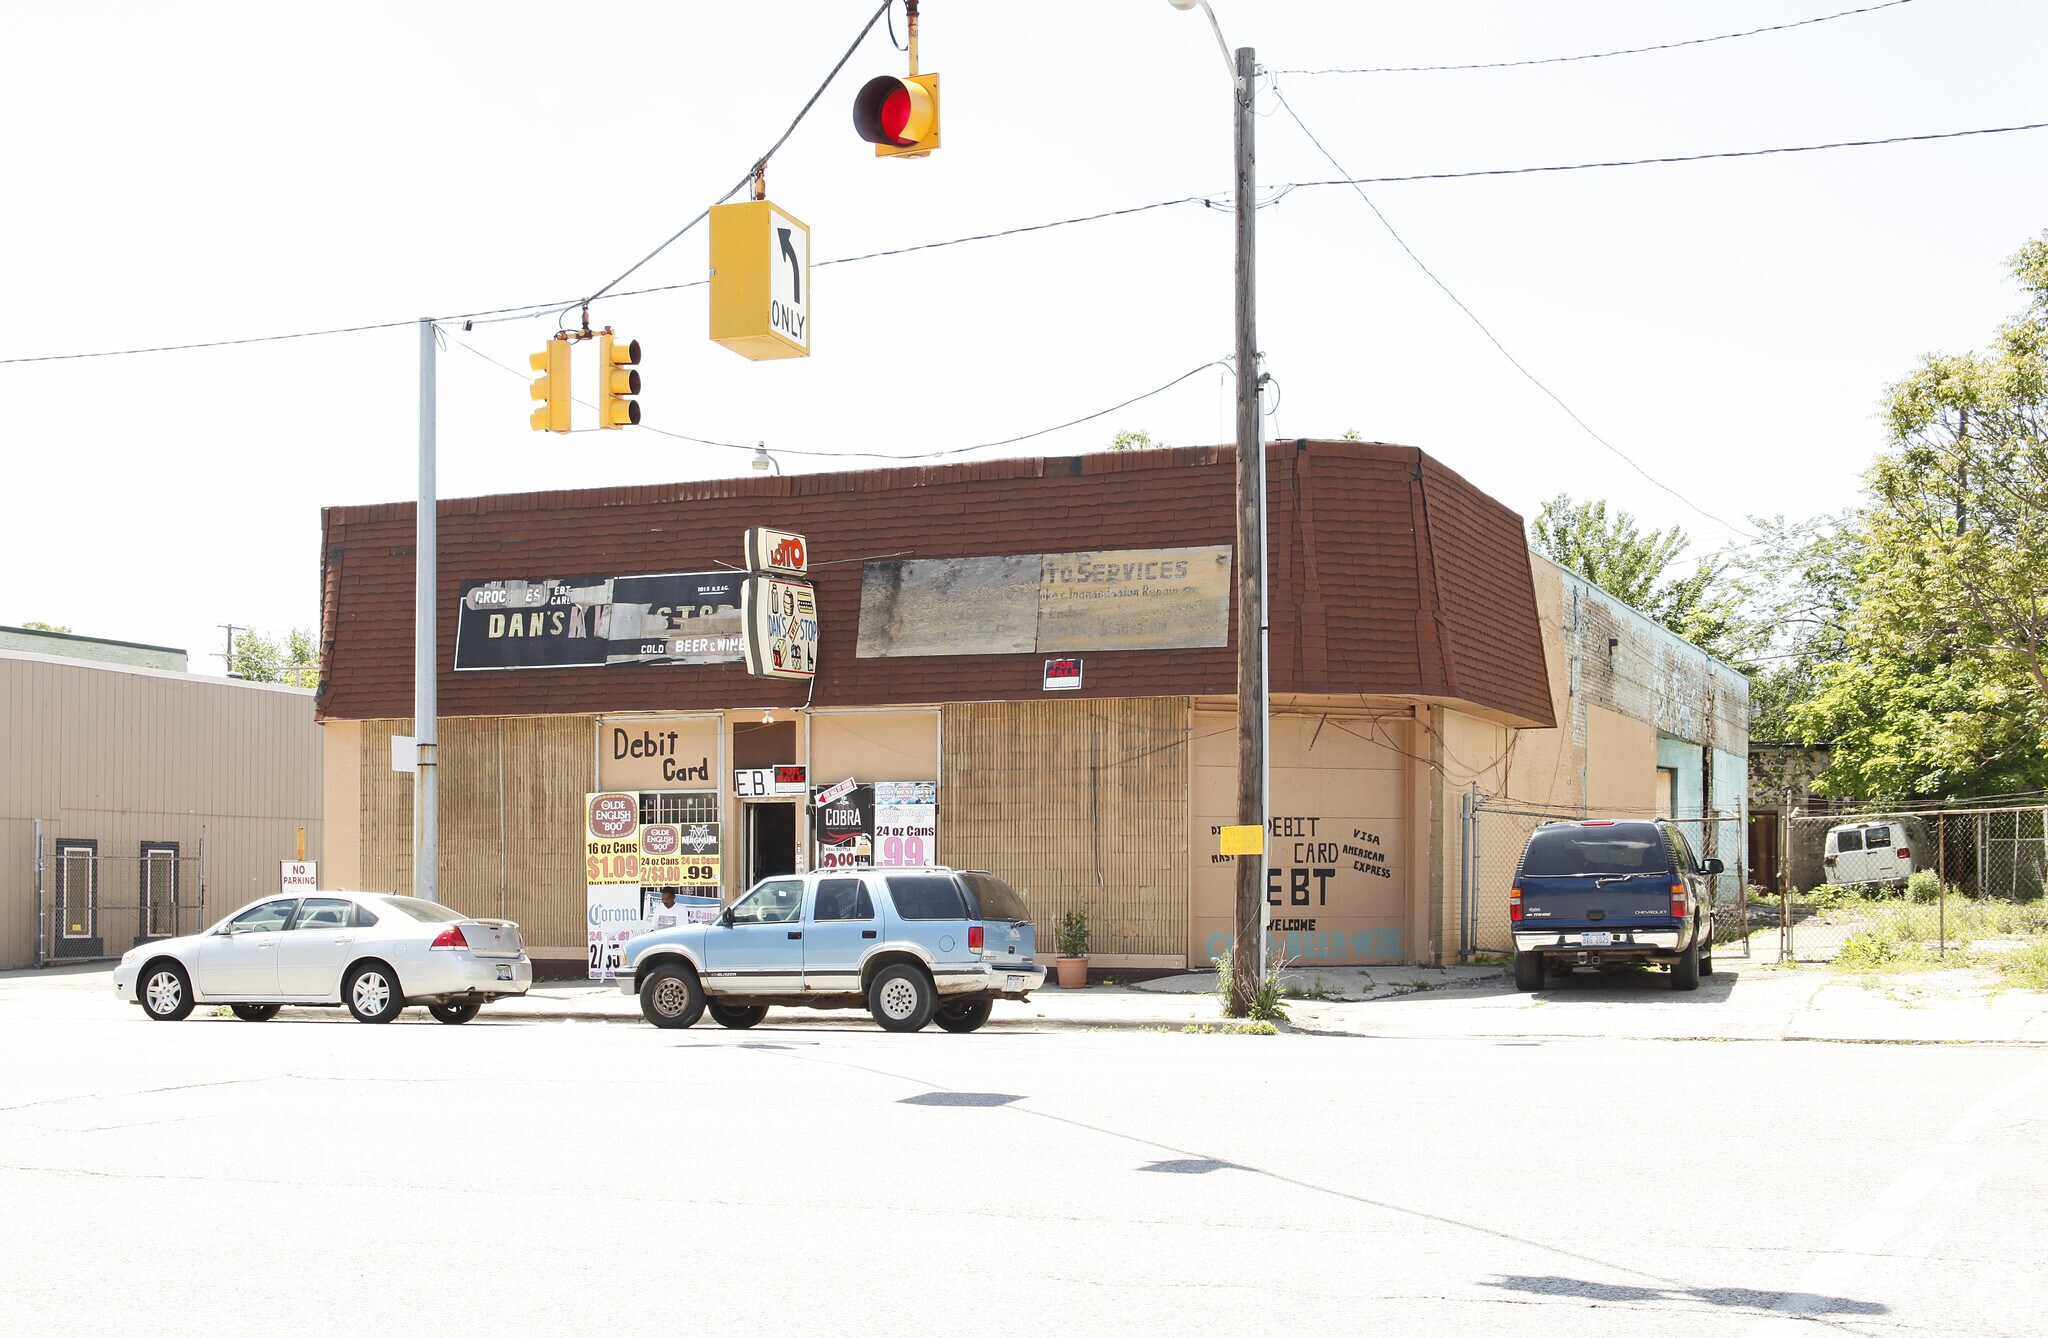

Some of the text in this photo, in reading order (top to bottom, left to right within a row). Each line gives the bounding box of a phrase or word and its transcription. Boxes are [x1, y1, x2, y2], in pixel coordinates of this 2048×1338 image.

[772, 300, 805, 339] ONLY
[770, 538, 804, 569] LOTTO
[1077, 560, 1188, 584] SERVICES
[475, 588, 541, 604] GROCES
[488, 611, 565, 639] DAN'S
[768, 614, 787, 639] DAN'S
[800, 618, 817, 642] STOP
[640, 644, 664, 654] COLD
[675, 639, 708, 652] BEER
[1048, 669, 1079, 677] SALE
[614, 728, 678, 760] Debit
[663, 757, 708, 781] Card
[601, 800, 625, 810] OLDE
[595, 810, 631, 821] ENGLISH
[825, 808, 862, 826] COBRA
[876, 825, 935, 836] 24 oz Cans
[1267, 817, 1320, 837] EBIT
[1354, 828, 1380, 845] VISA
[587, 842, 638, 854] 16 oz Cans
[1294, 843, 1339, 864] CARD
[1342, 844, 1385, 862] AMERICAN
[293, 865, 305, 874] NO
[587, 855, 639, 880] $1.09
[641, 858, 651, 866] 24
[660, 857, 679, 865] Cans
[1354, 861, 1391, 878] EXPRESS
[283, 876, 315, 885] PARKING
[641, 866, 680, 882] 2/$3.00
[1267, 868, 1336, 906] EBT
[588, 903, 638, 926] Corona
